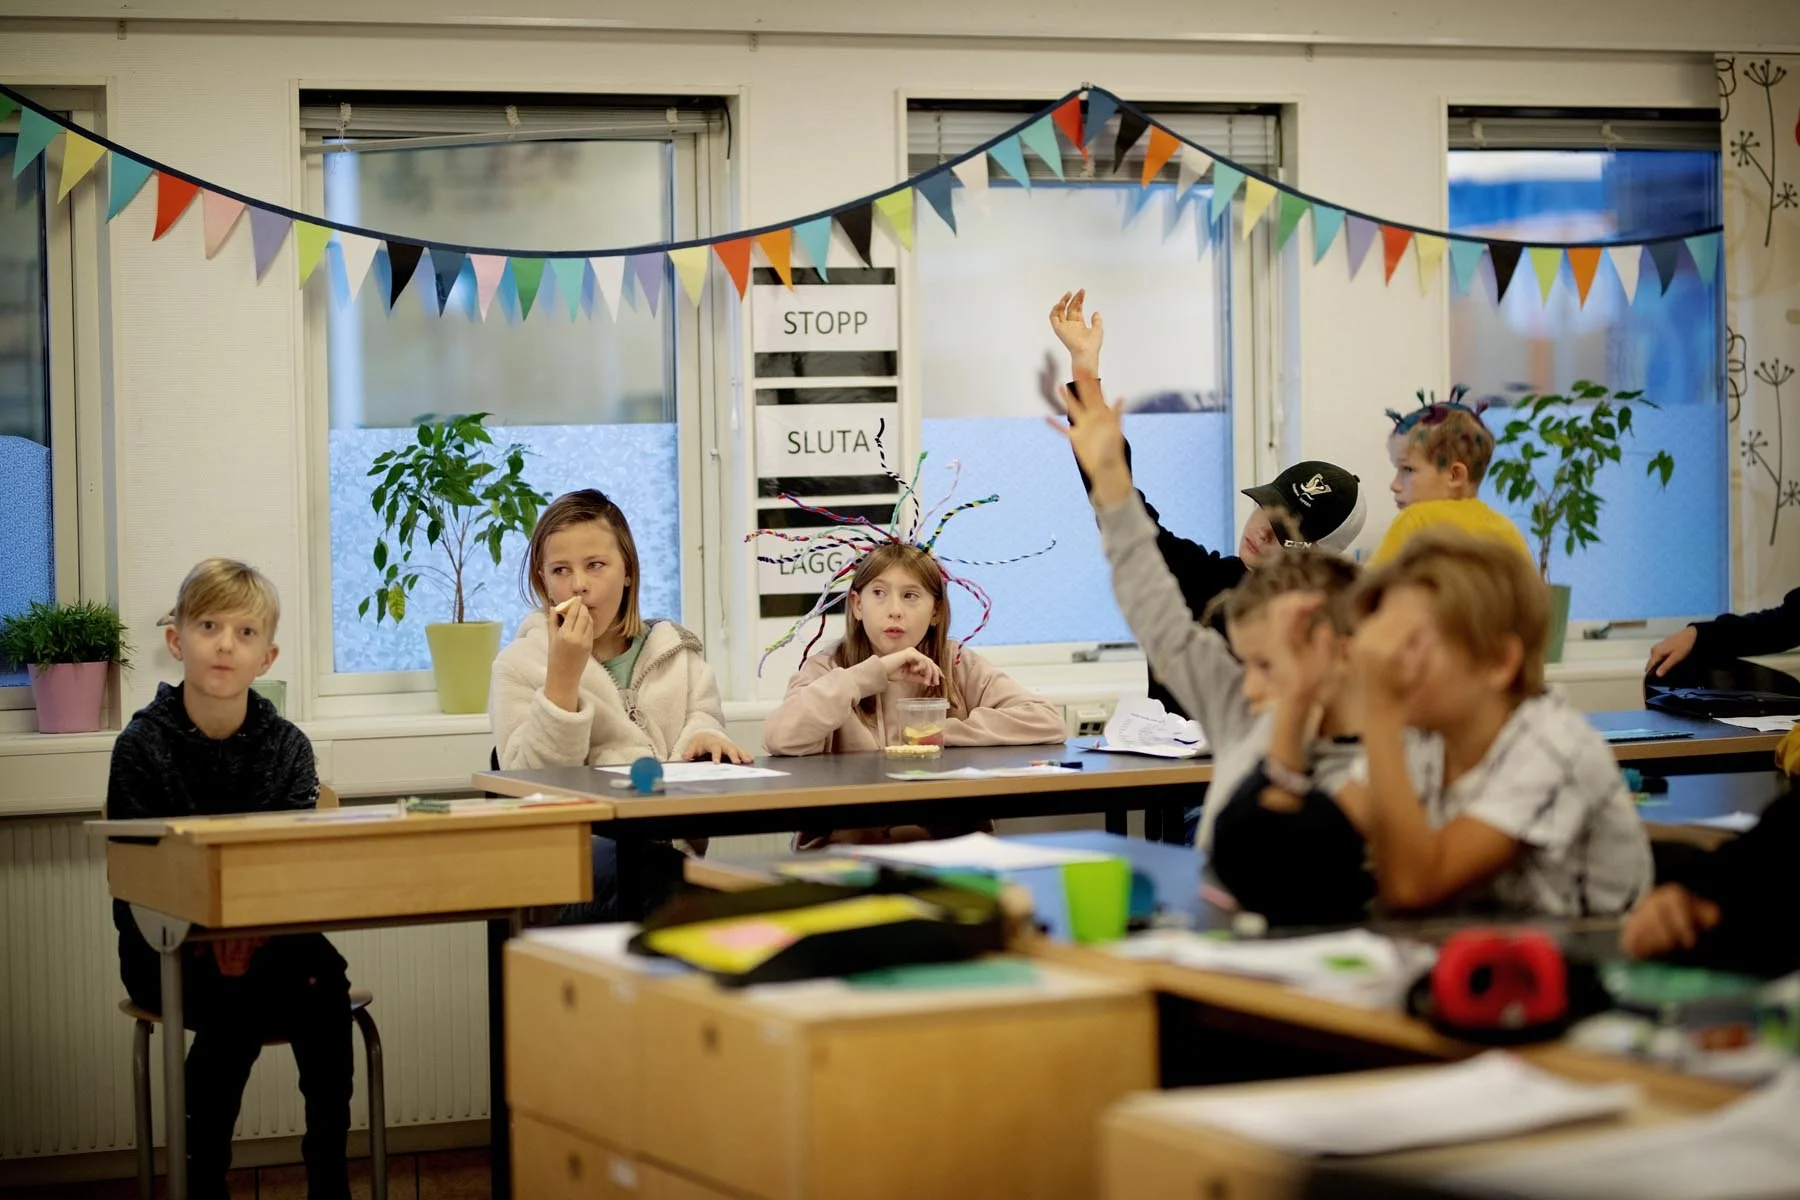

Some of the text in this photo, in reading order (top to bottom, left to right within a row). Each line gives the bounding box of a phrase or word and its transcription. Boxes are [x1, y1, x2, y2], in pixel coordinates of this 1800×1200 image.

[783, 310, 868, 335] STOPP
[787, 429, 870, 455] SLUTA
[779, 548, 843, 575] LÄGG
